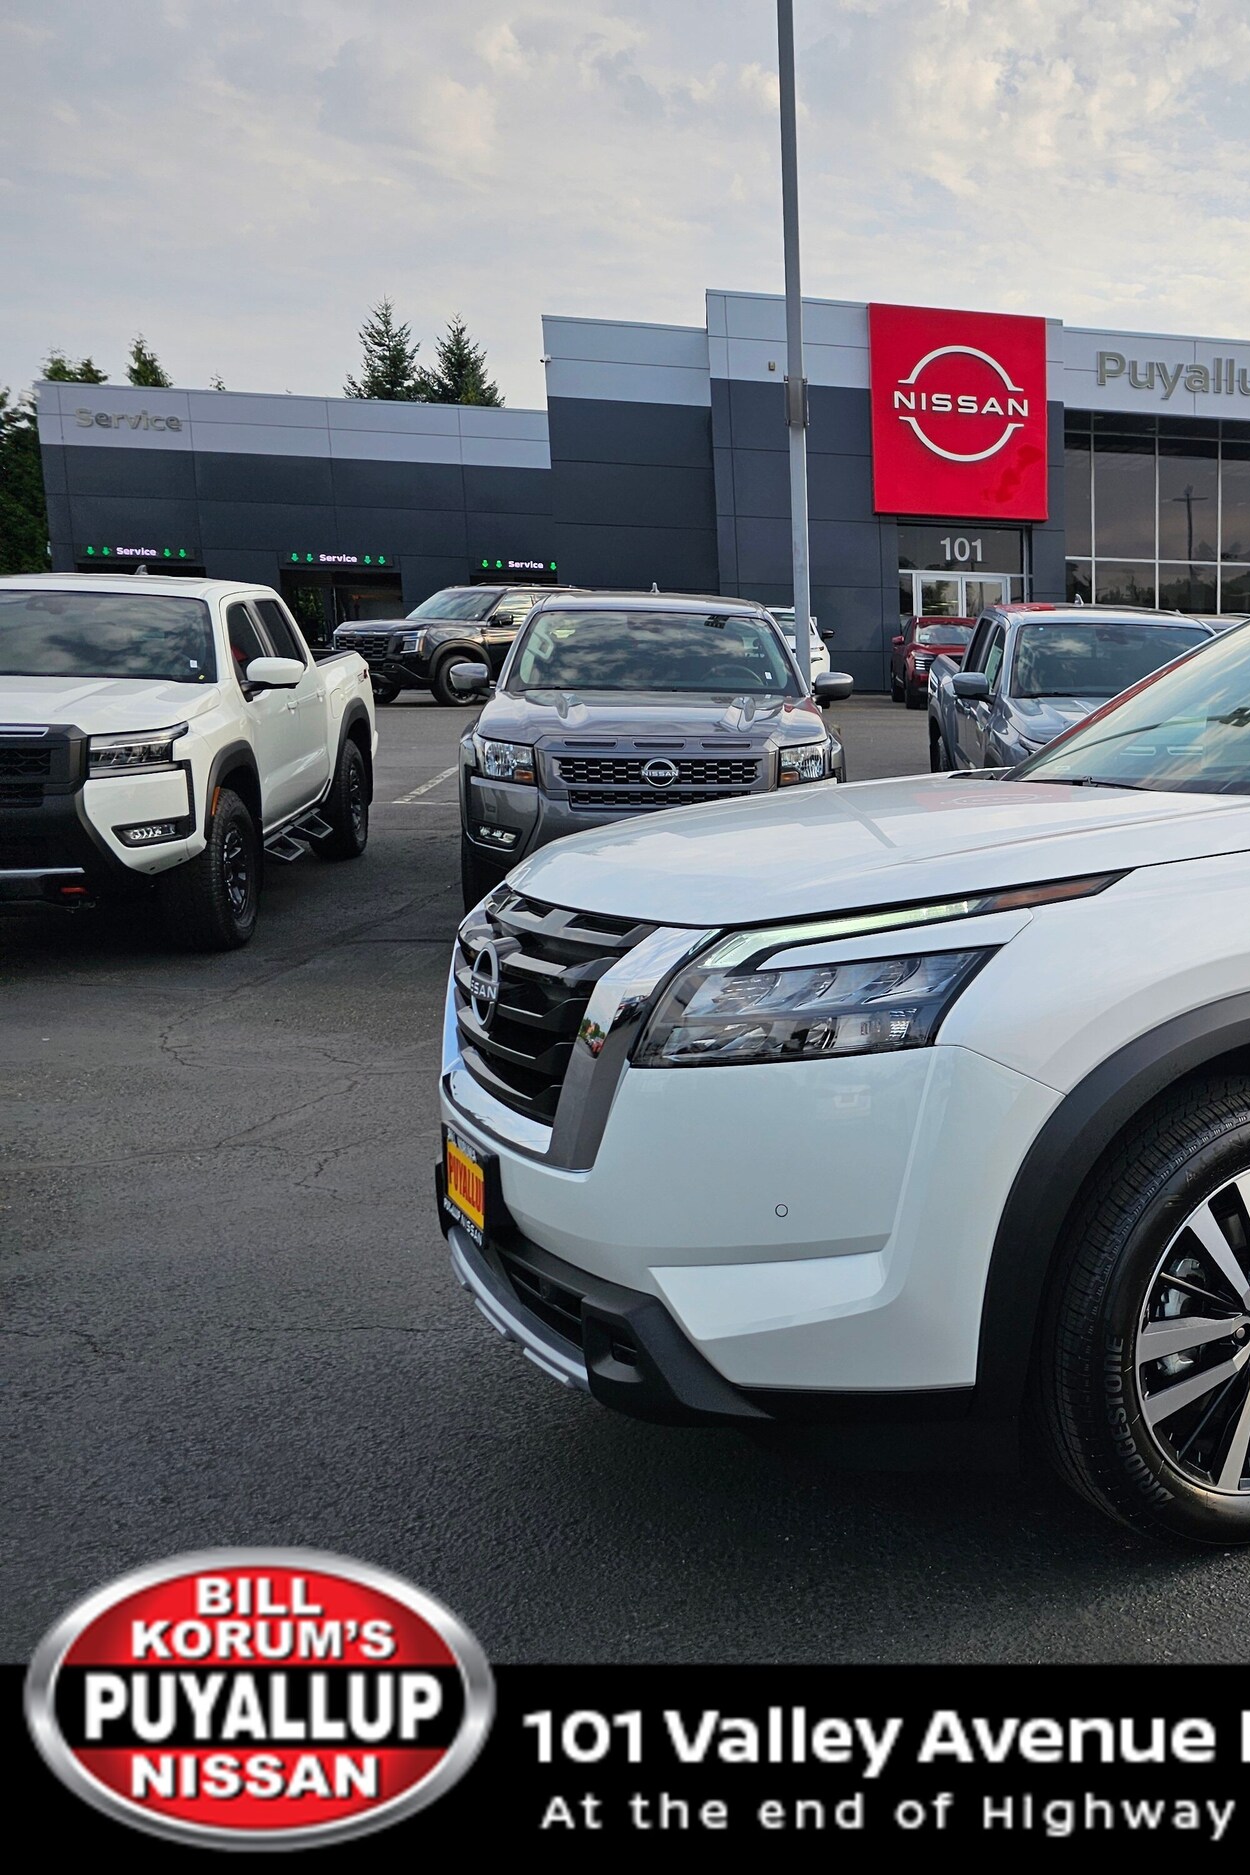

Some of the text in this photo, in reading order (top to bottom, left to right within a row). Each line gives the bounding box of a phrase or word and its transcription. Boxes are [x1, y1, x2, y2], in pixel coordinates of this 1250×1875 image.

[893, 390, 1029, 417] NISSAN
[75, 408, 182, 432] Service
[116, 547, 157, 556] Service
[319, 554, 358, 563] Service
[940, 537, 983, 562] 101
[508, 561, 544, 569] Service
[471, 980, 497, 999] SSAN
[1103, 1335, 1175, 1506] BRIDGESTONE
